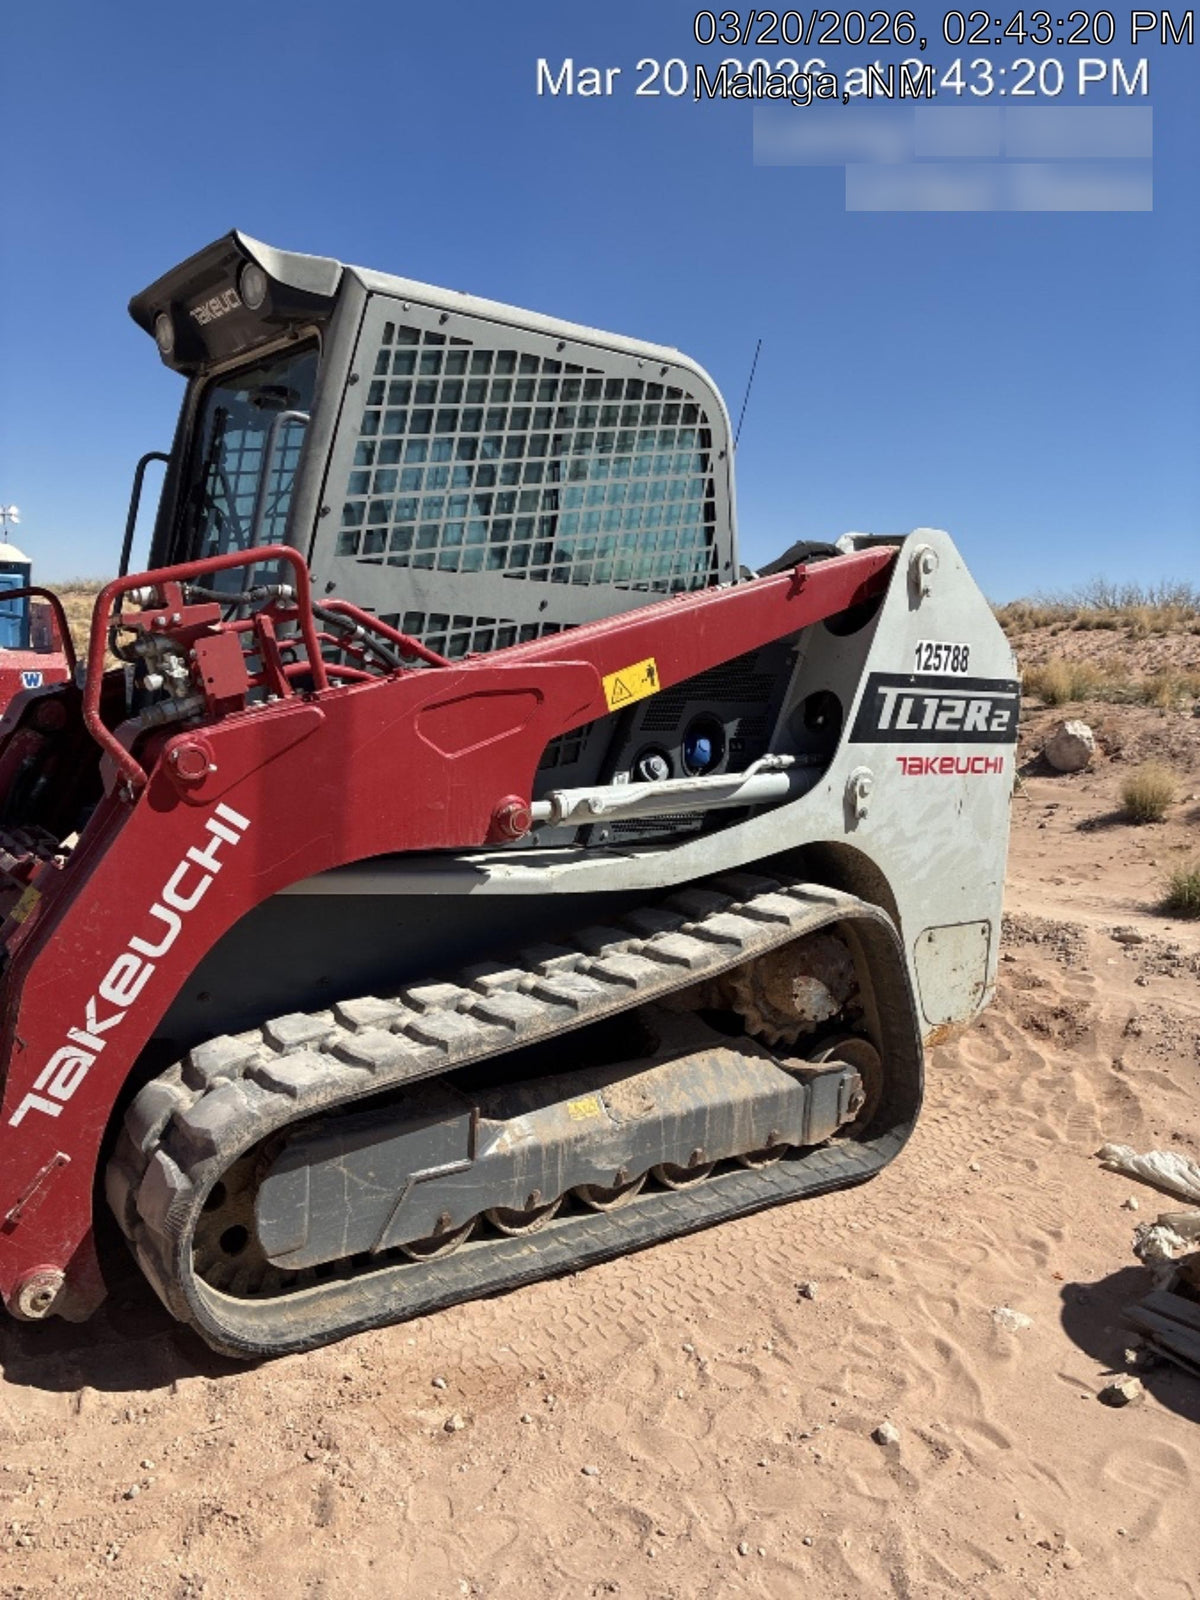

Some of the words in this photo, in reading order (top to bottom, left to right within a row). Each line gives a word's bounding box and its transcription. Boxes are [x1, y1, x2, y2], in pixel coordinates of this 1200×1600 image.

[915, 642, 970, 673] 125788
[896, 756, 1004, 776] TAKEUCHI
[8, 802, 251, 1127] TAKEUCHI
